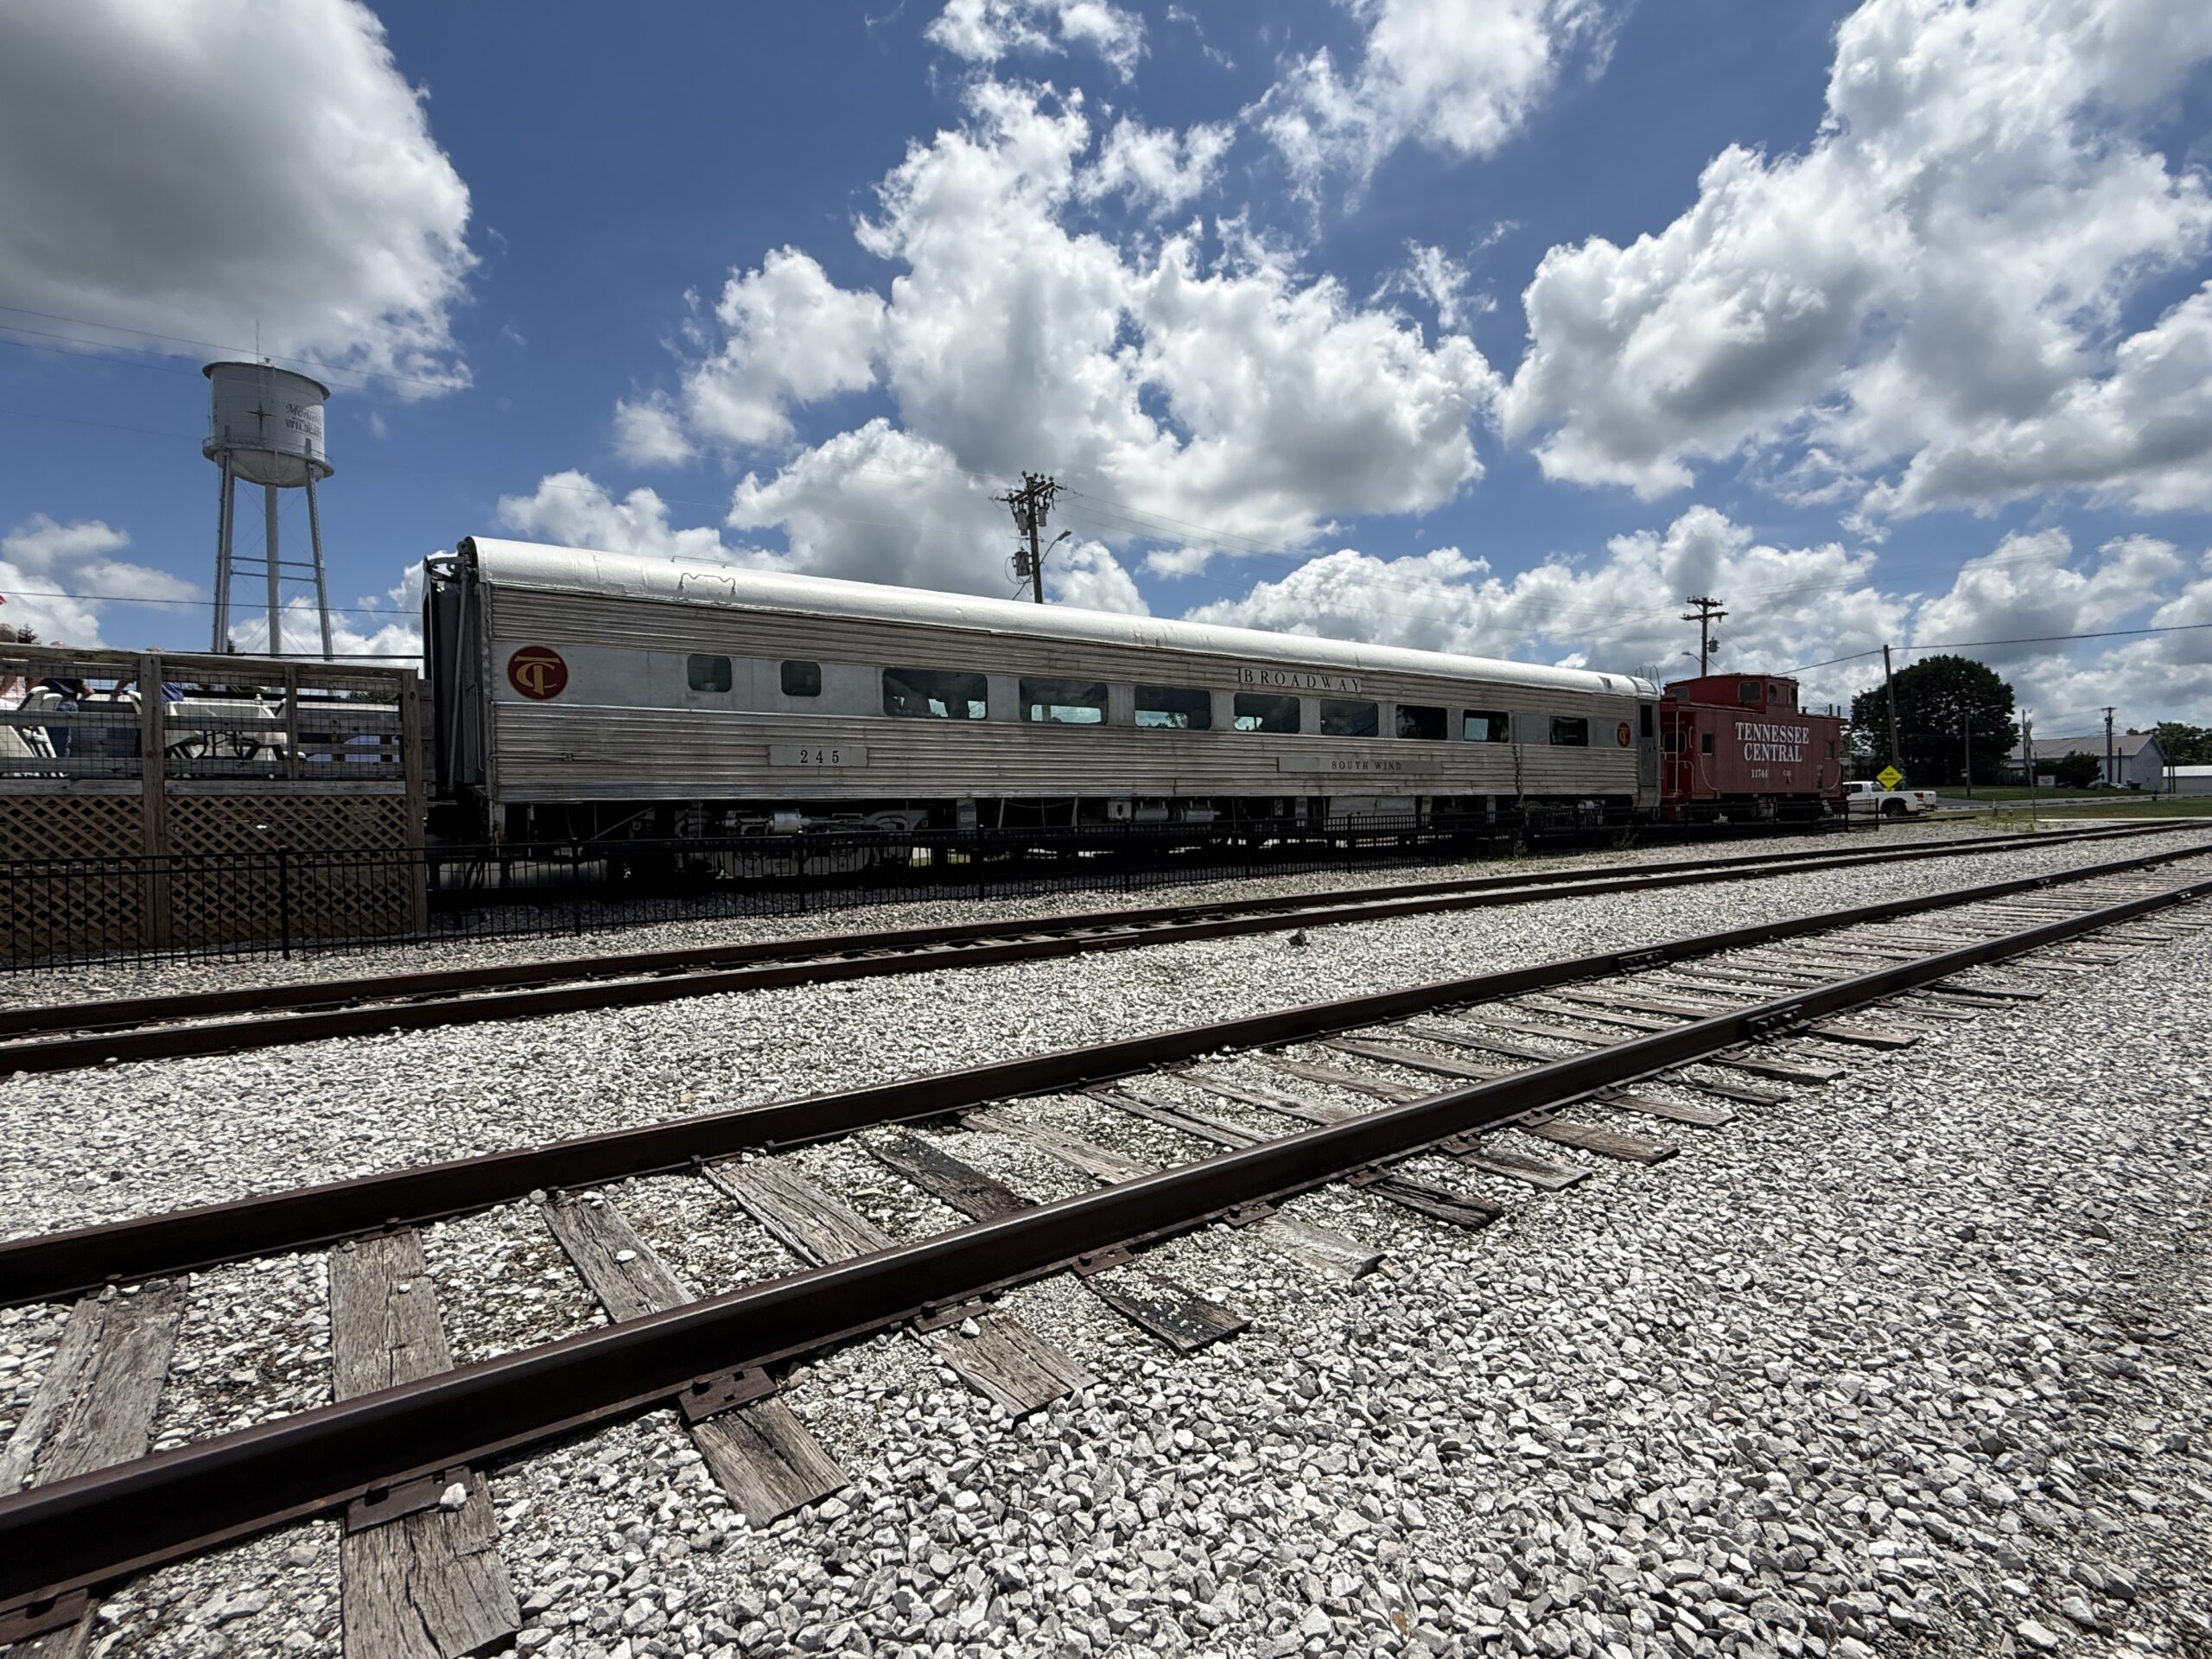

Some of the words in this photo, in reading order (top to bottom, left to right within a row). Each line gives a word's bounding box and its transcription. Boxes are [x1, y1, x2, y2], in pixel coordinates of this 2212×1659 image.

[1244, 669, 1360, 691] BROADWAY
[1735, 721, 1809, 744] TENNESSEE
[1744, 742, 1802, 762] CENTRAL
[1332, 760, 1369, 770] SOUTH
[1374, 761, 1402, 771] WIND
